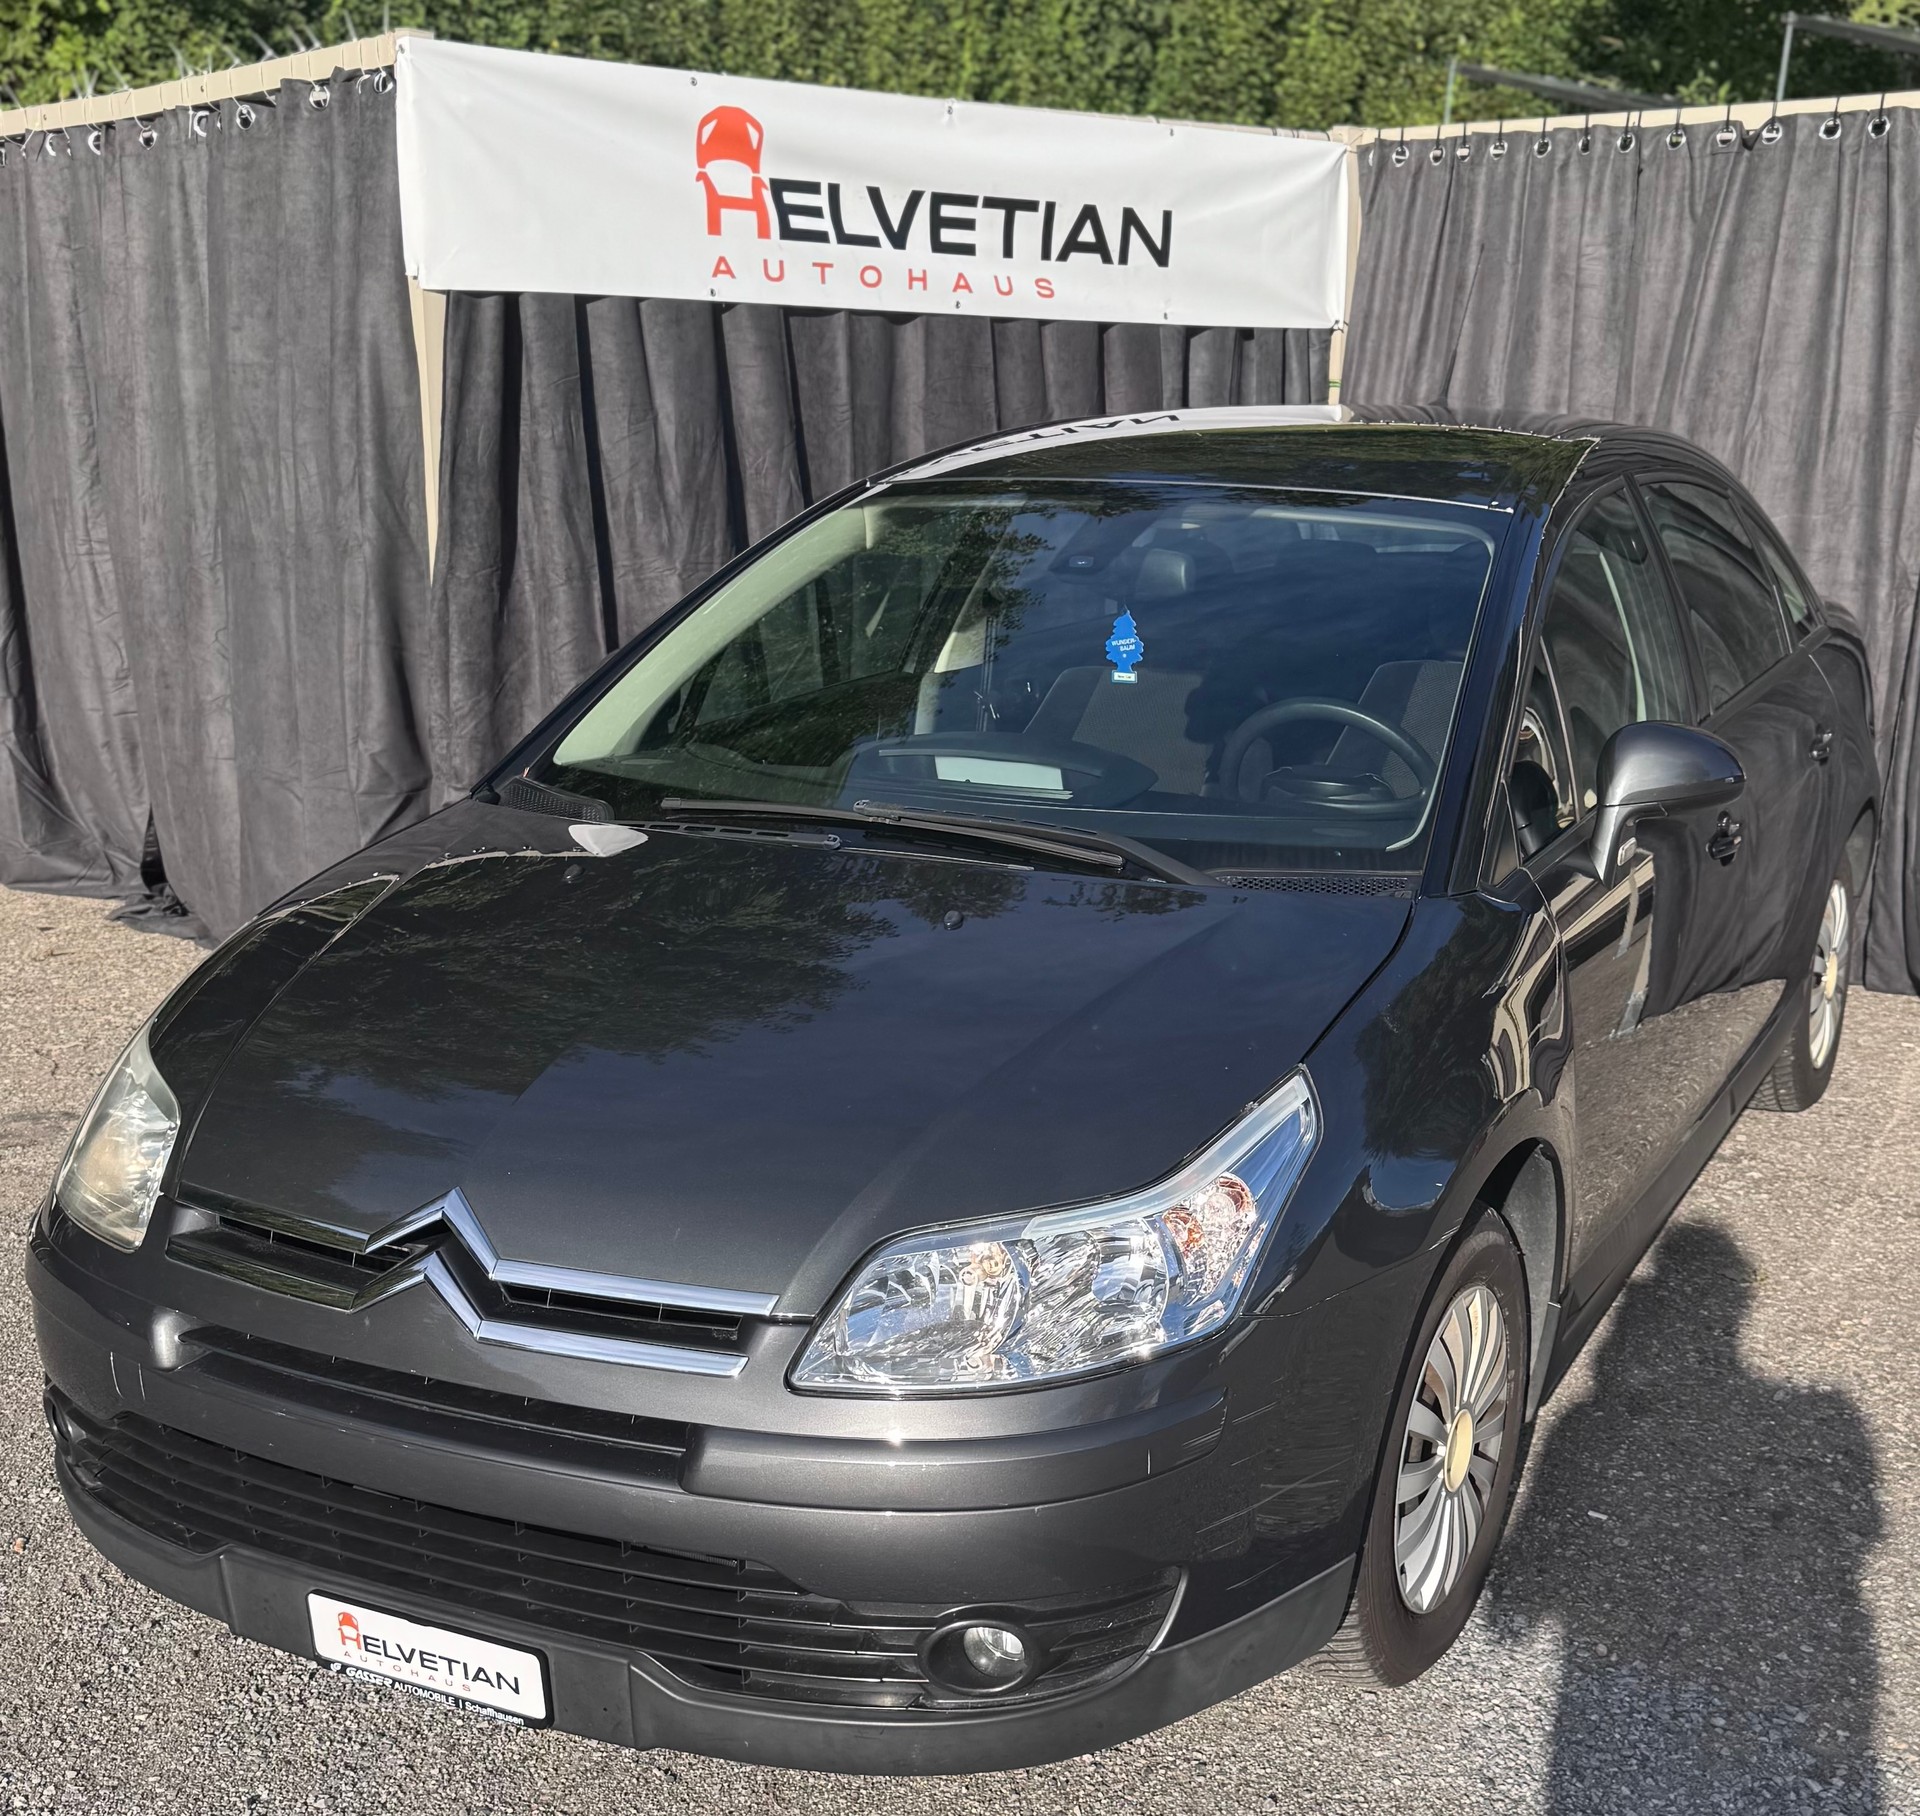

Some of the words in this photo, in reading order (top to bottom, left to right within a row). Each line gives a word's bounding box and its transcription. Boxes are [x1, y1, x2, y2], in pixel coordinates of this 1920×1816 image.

[695, 169, 1173, 268] HELVETIAN
[711, 255, 1056, 299] AUTOHAUS
[337, 1627, 520, 1695] HELVETIAN
[343, 1651, 471, 1692] AUTOHAUS
[393, 1681, 456, 1707] AUTOMOBILE
